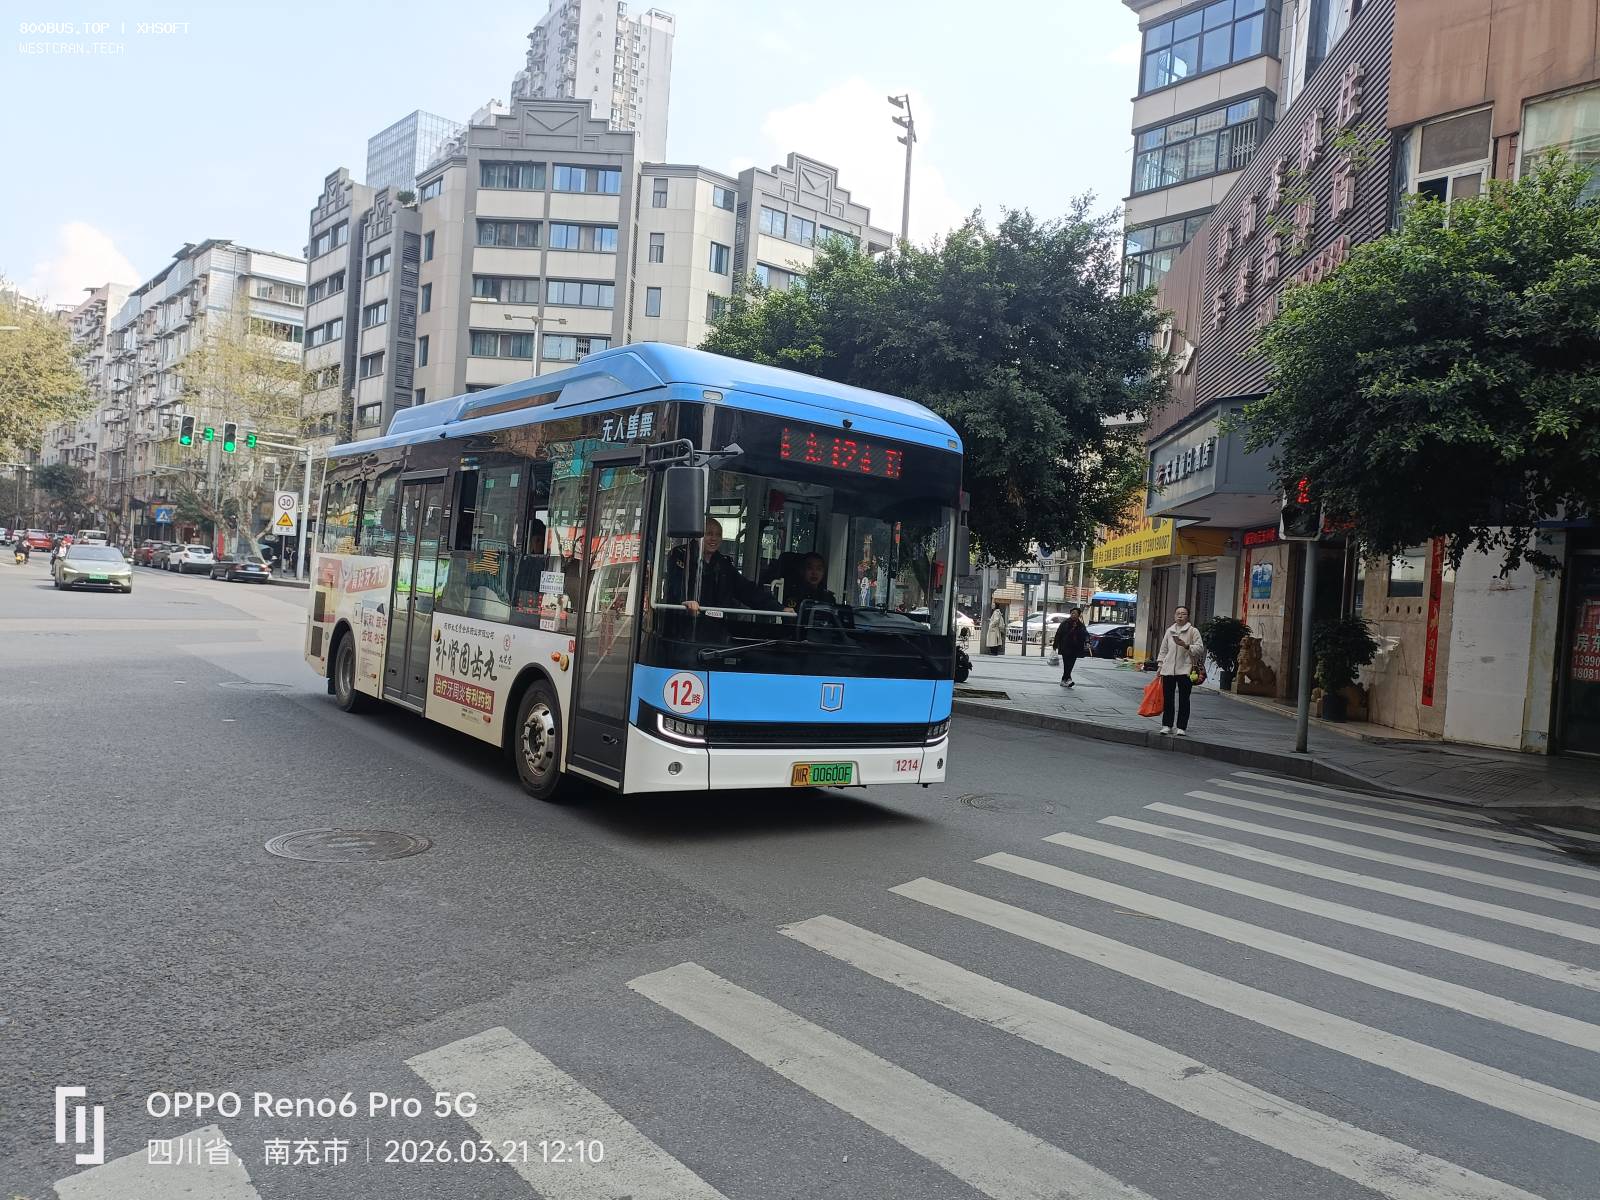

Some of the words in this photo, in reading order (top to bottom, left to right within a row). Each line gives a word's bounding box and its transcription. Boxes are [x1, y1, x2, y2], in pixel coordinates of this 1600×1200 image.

[601, 411, 655, 442] 无人售票
[281, 498, 291, 507] 30
[435, 638, 498, 682] 补肾固齿丸
[434, 676, 493, 711] 治疗牙周炎专利药物
[895, 759, 919, 772] 1214
